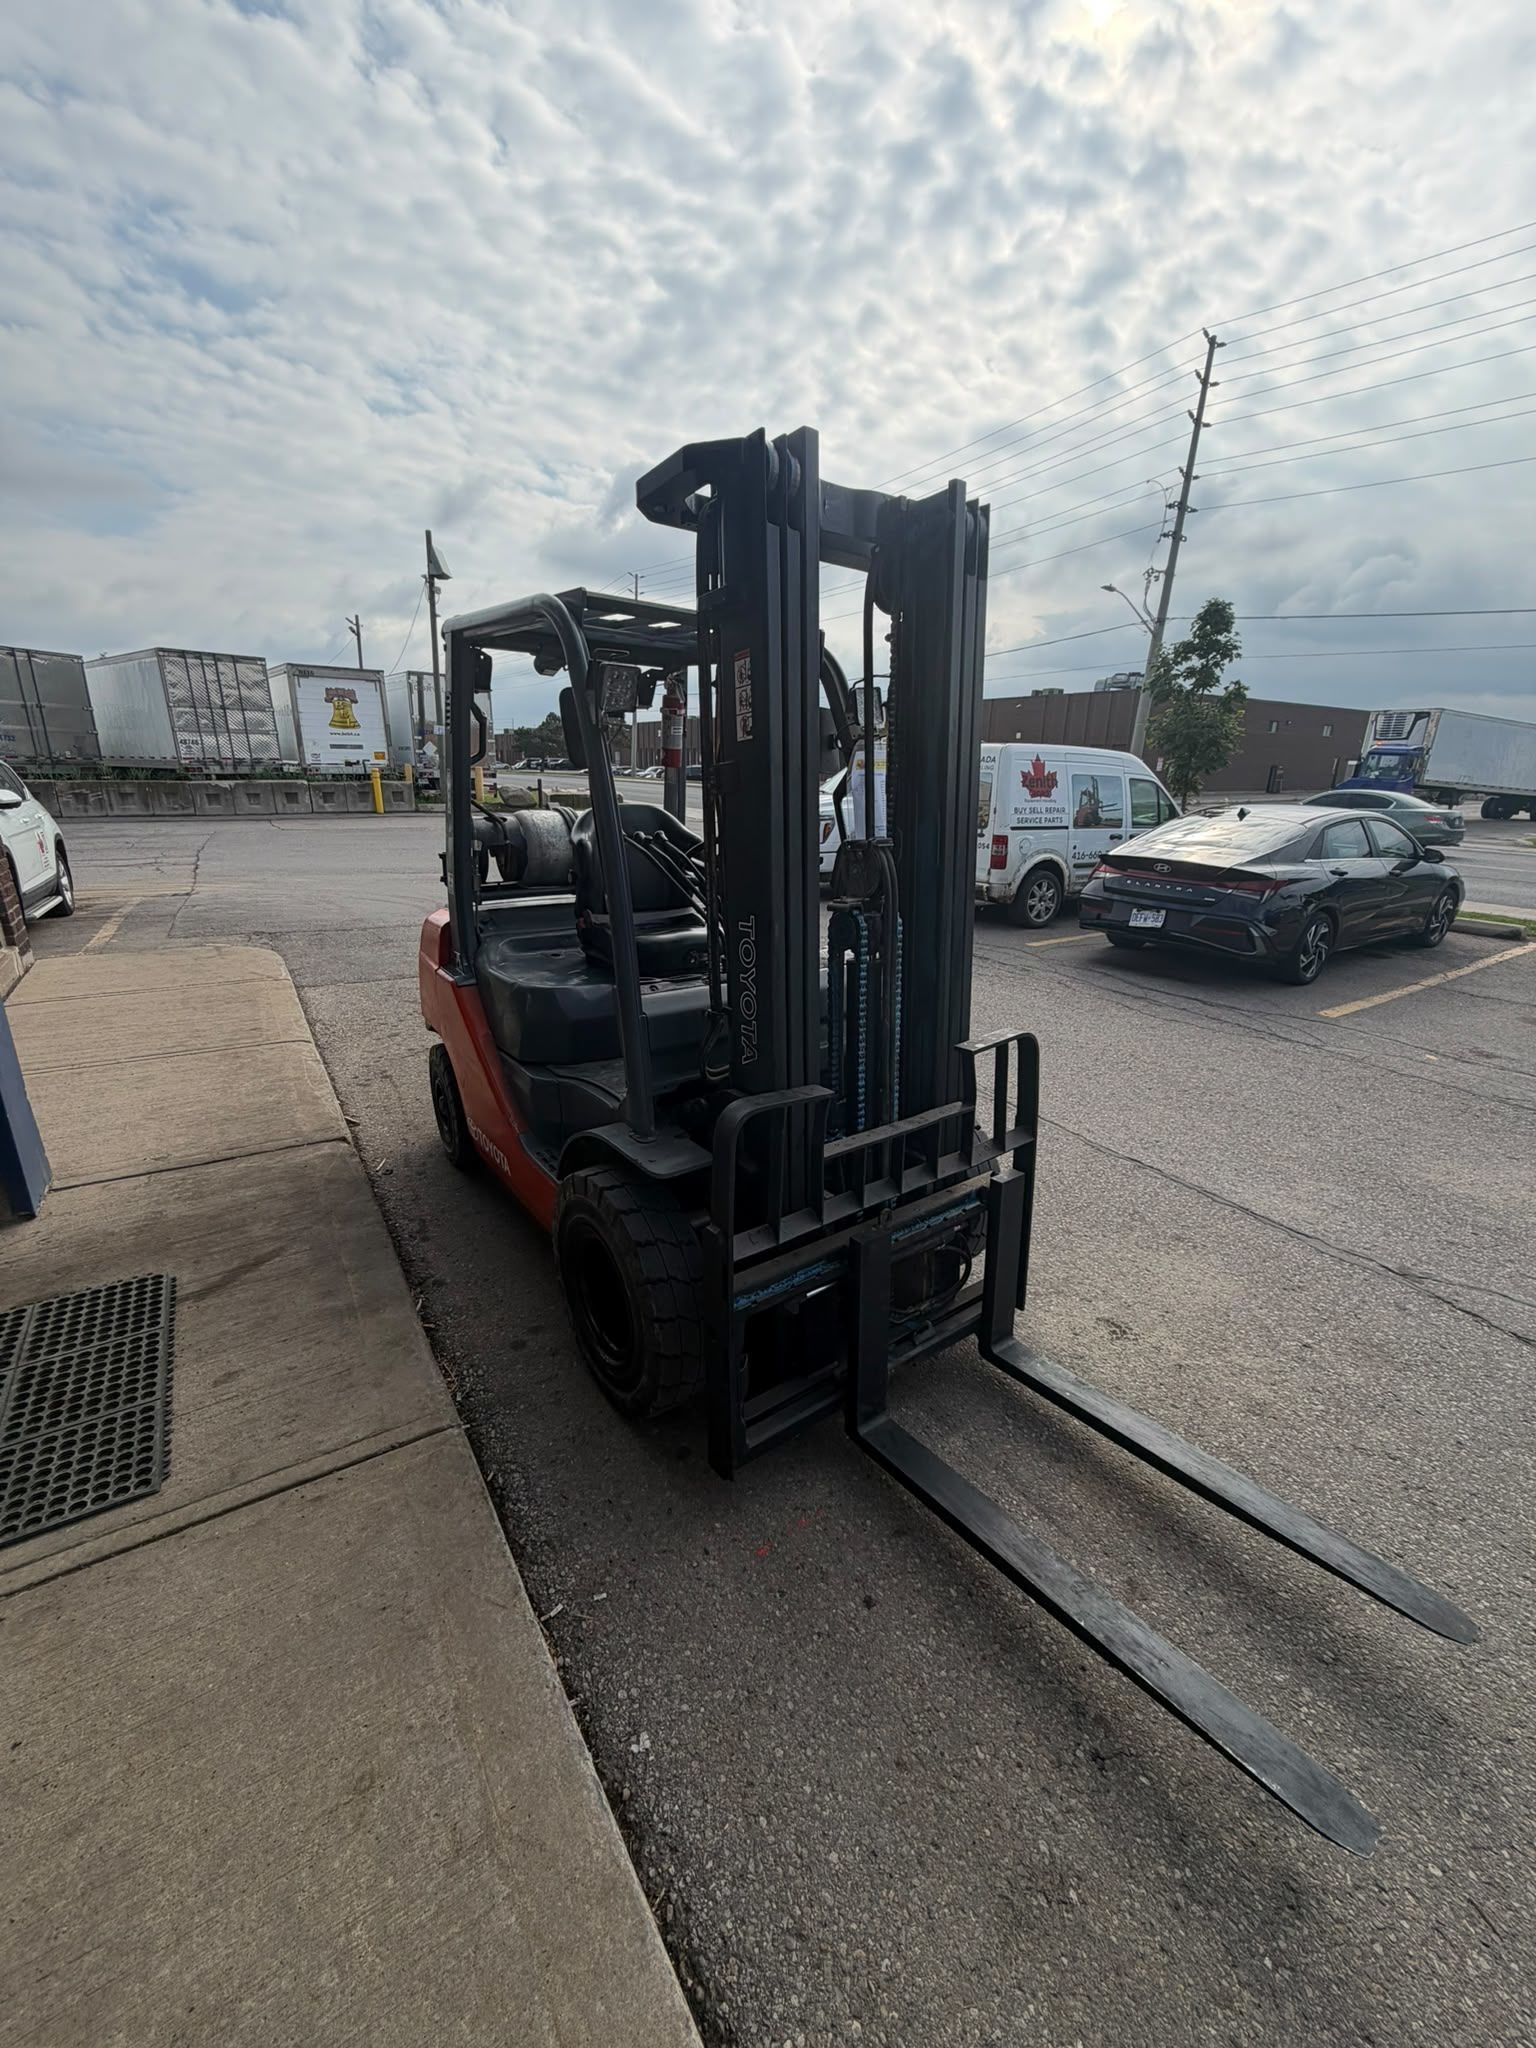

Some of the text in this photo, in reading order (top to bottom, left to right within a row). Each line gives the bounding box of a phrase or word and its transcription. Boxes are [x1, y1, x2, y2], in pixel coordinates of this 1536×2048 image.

[1013, 807, 1066, 815] BUY SELL REPAIR
[1016, 816, 1063, 824] SERVICE PARTS
[738, 914, 758, 1066] TOYOTA
